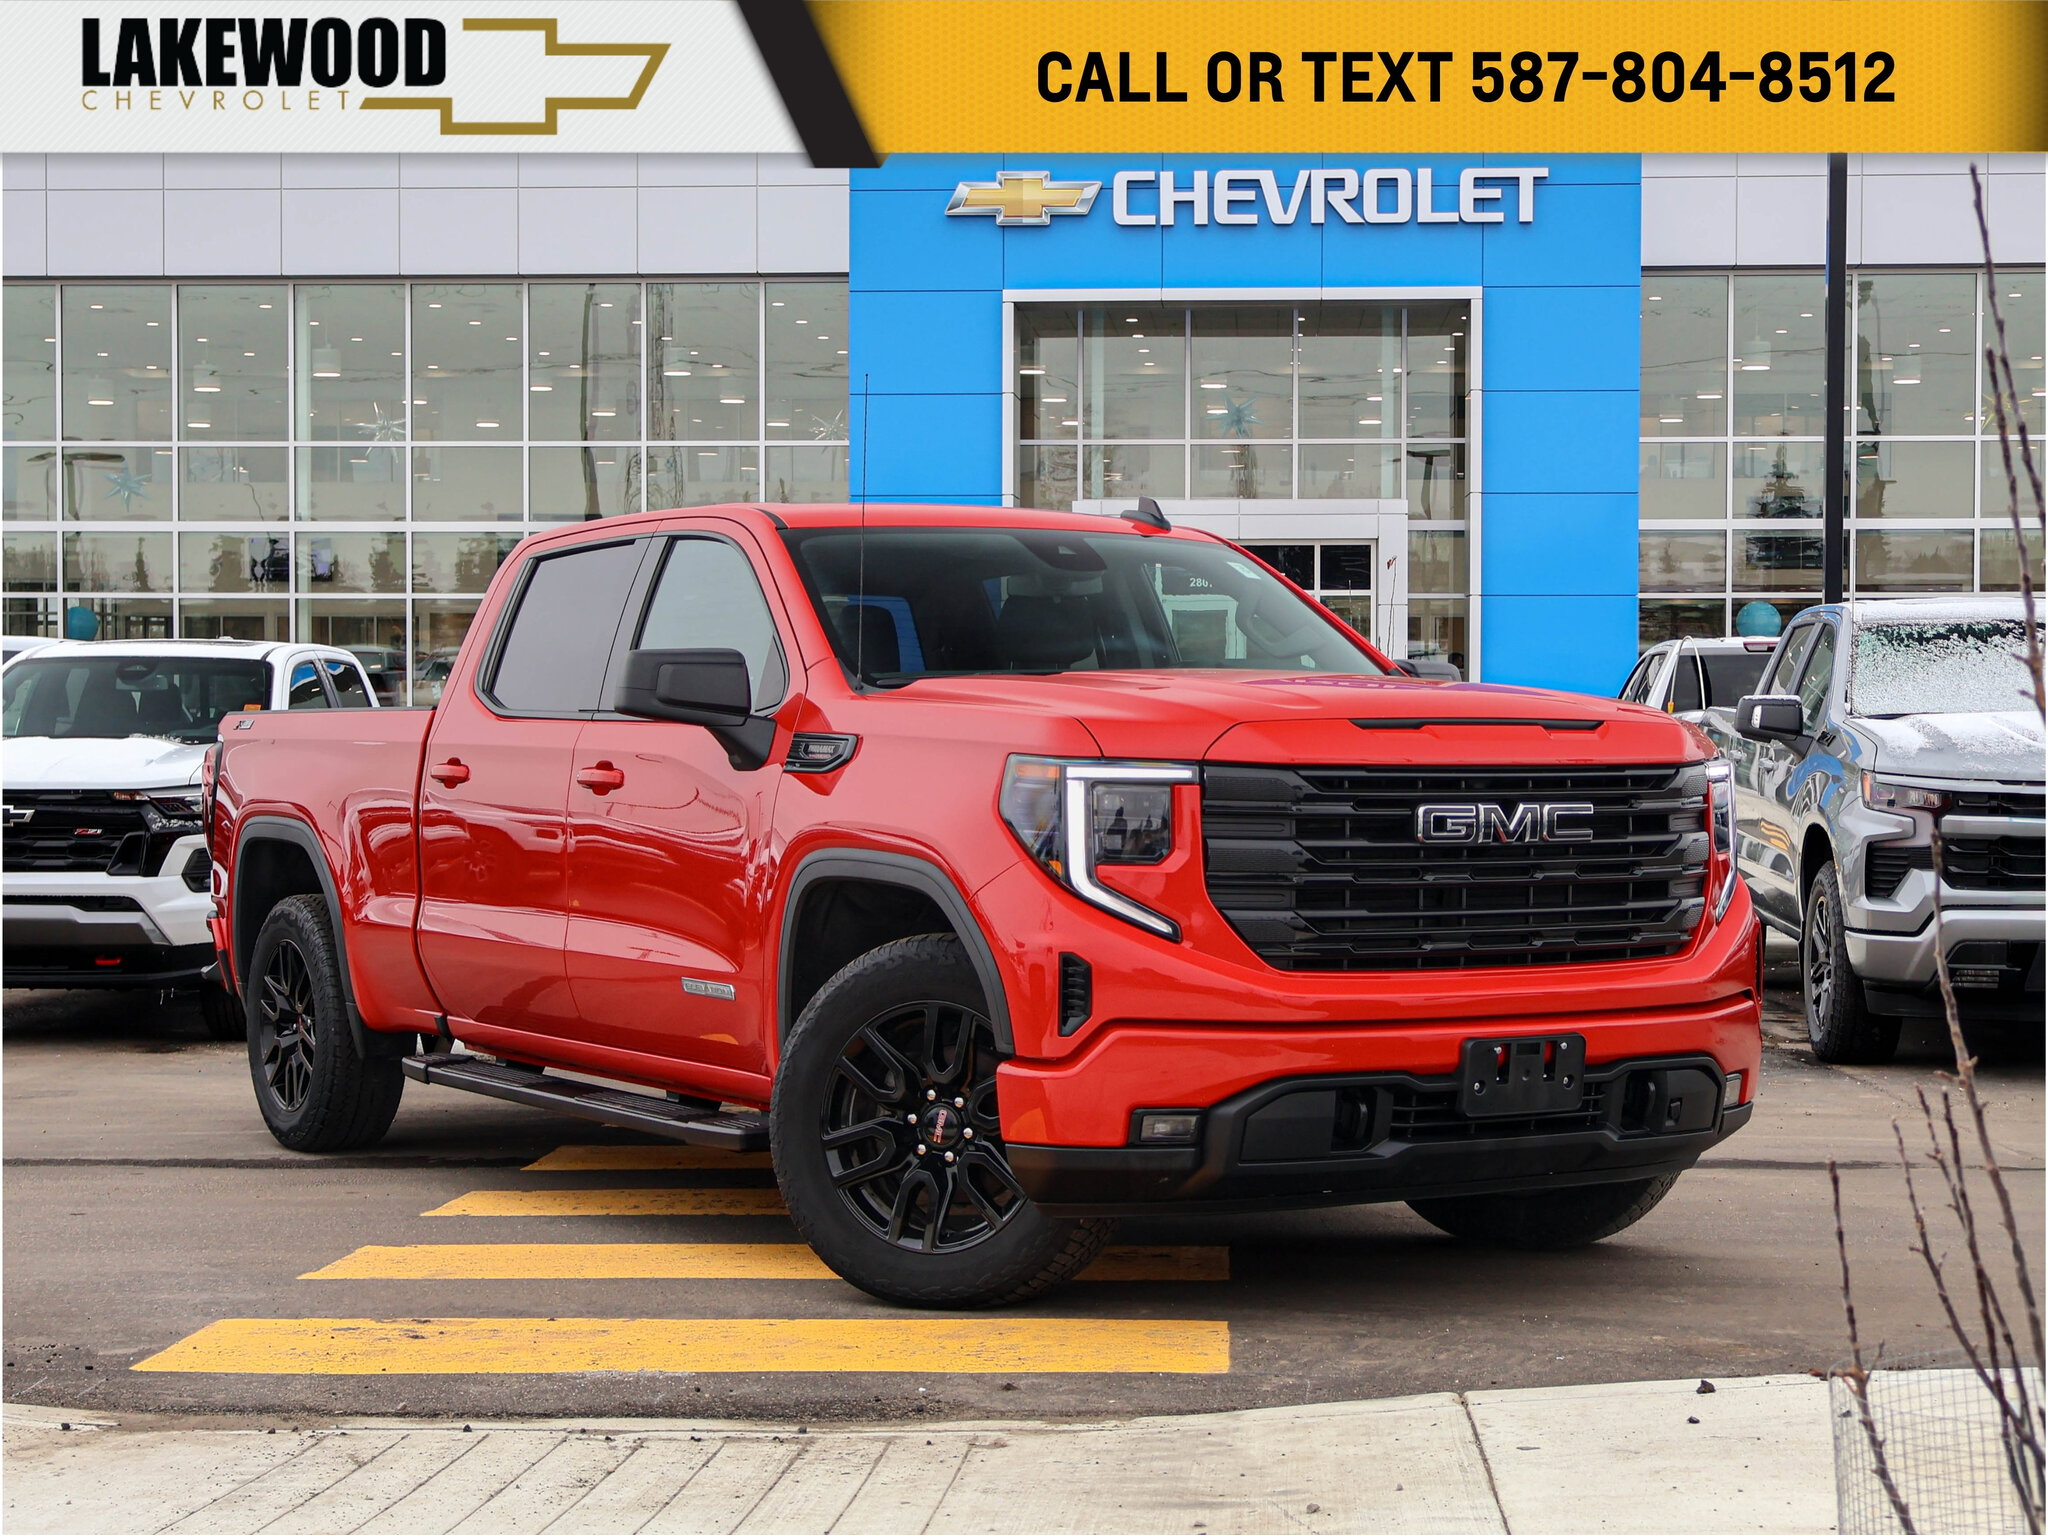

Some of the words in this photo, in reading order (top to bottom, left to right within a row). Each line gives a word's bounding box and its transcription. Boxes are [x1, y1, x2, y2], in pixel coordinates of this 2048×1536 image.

[1112, 166, 1550, 227] CHEVROLET
[1415, 803, 1595, 845] GMC
[933, 1109, 948, 1143] GMC
